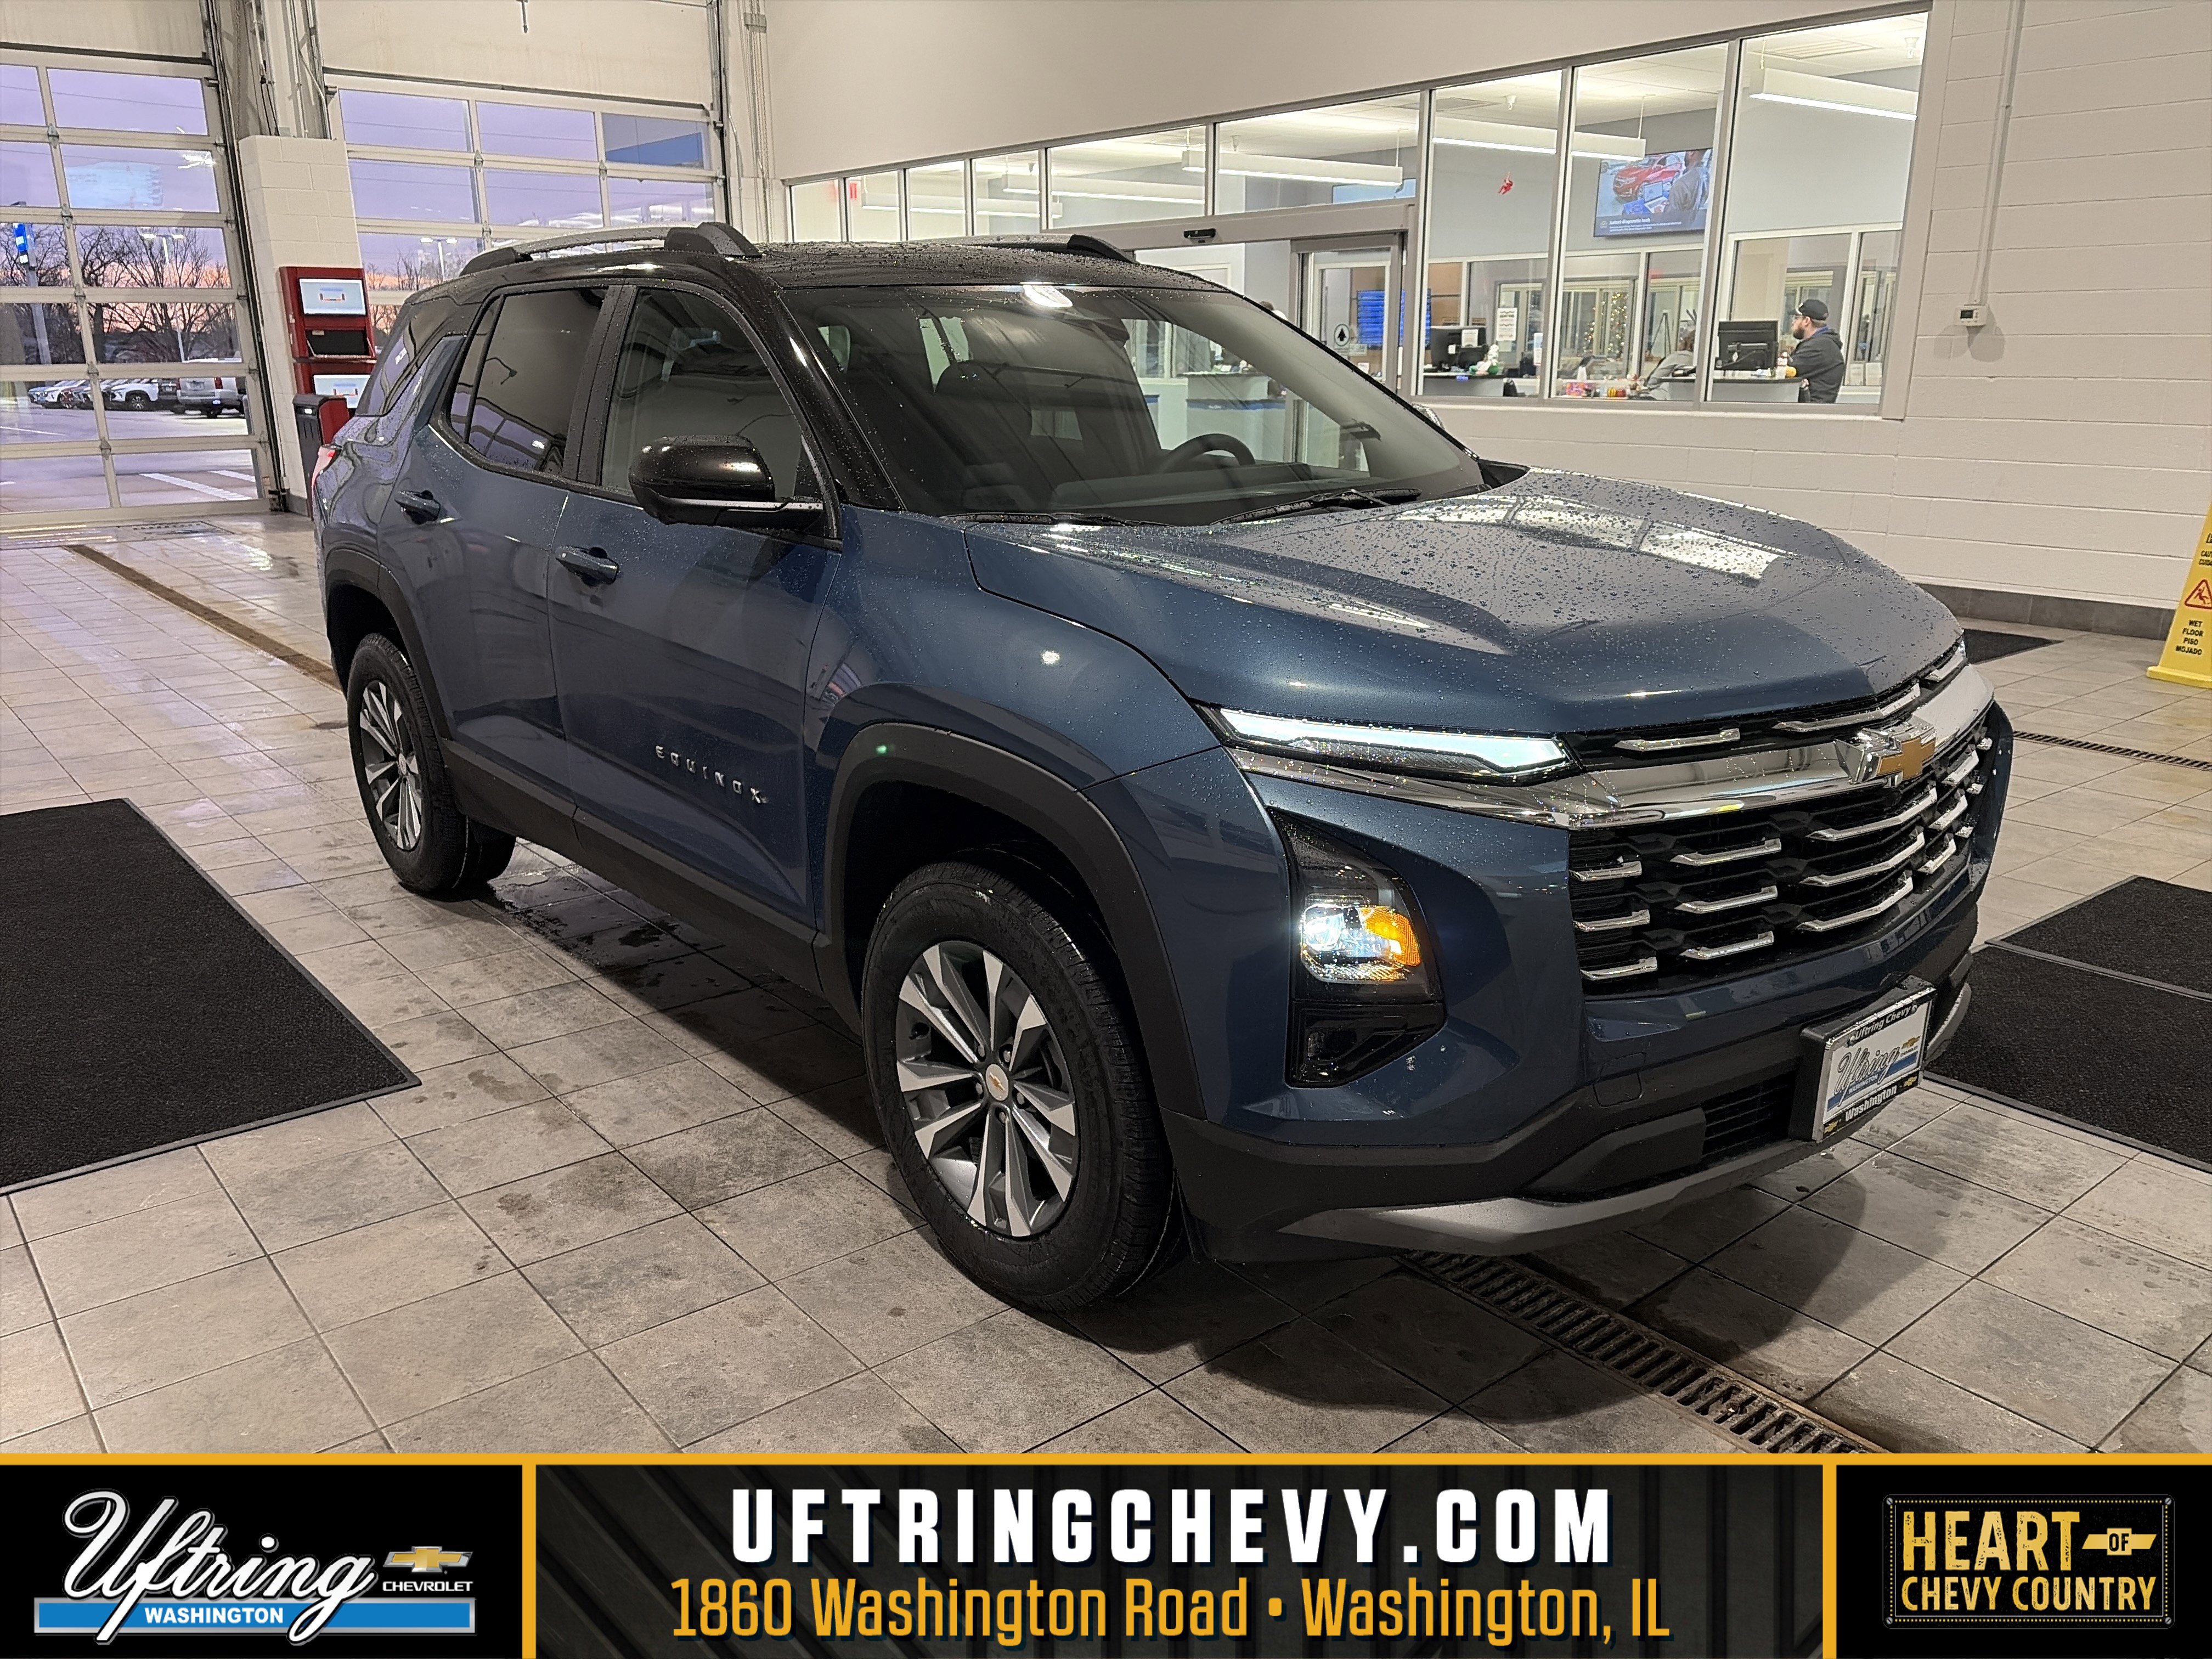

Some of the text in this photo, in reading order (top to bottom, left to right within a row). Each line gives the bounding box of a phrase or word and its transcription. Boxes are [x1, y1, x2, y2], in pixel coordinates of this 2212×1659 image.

[2182, 628, 2204, 636] FLOOR
[2188, 619, 2203, 628] WET
[2175, 645, 2203, 656] MOJADO
[2183, 637, 2199, 645] PISO
[655, 745, 764, 804] EQUINOX
[1855, 1006, 1911, 1040] Uftring Chevy
[1834, 1047, 1900, 1107] Uftring
[1848, 1074, 1878, 1094] WASHINGTON
[1845, 1085, 1898, 1122] Washington
